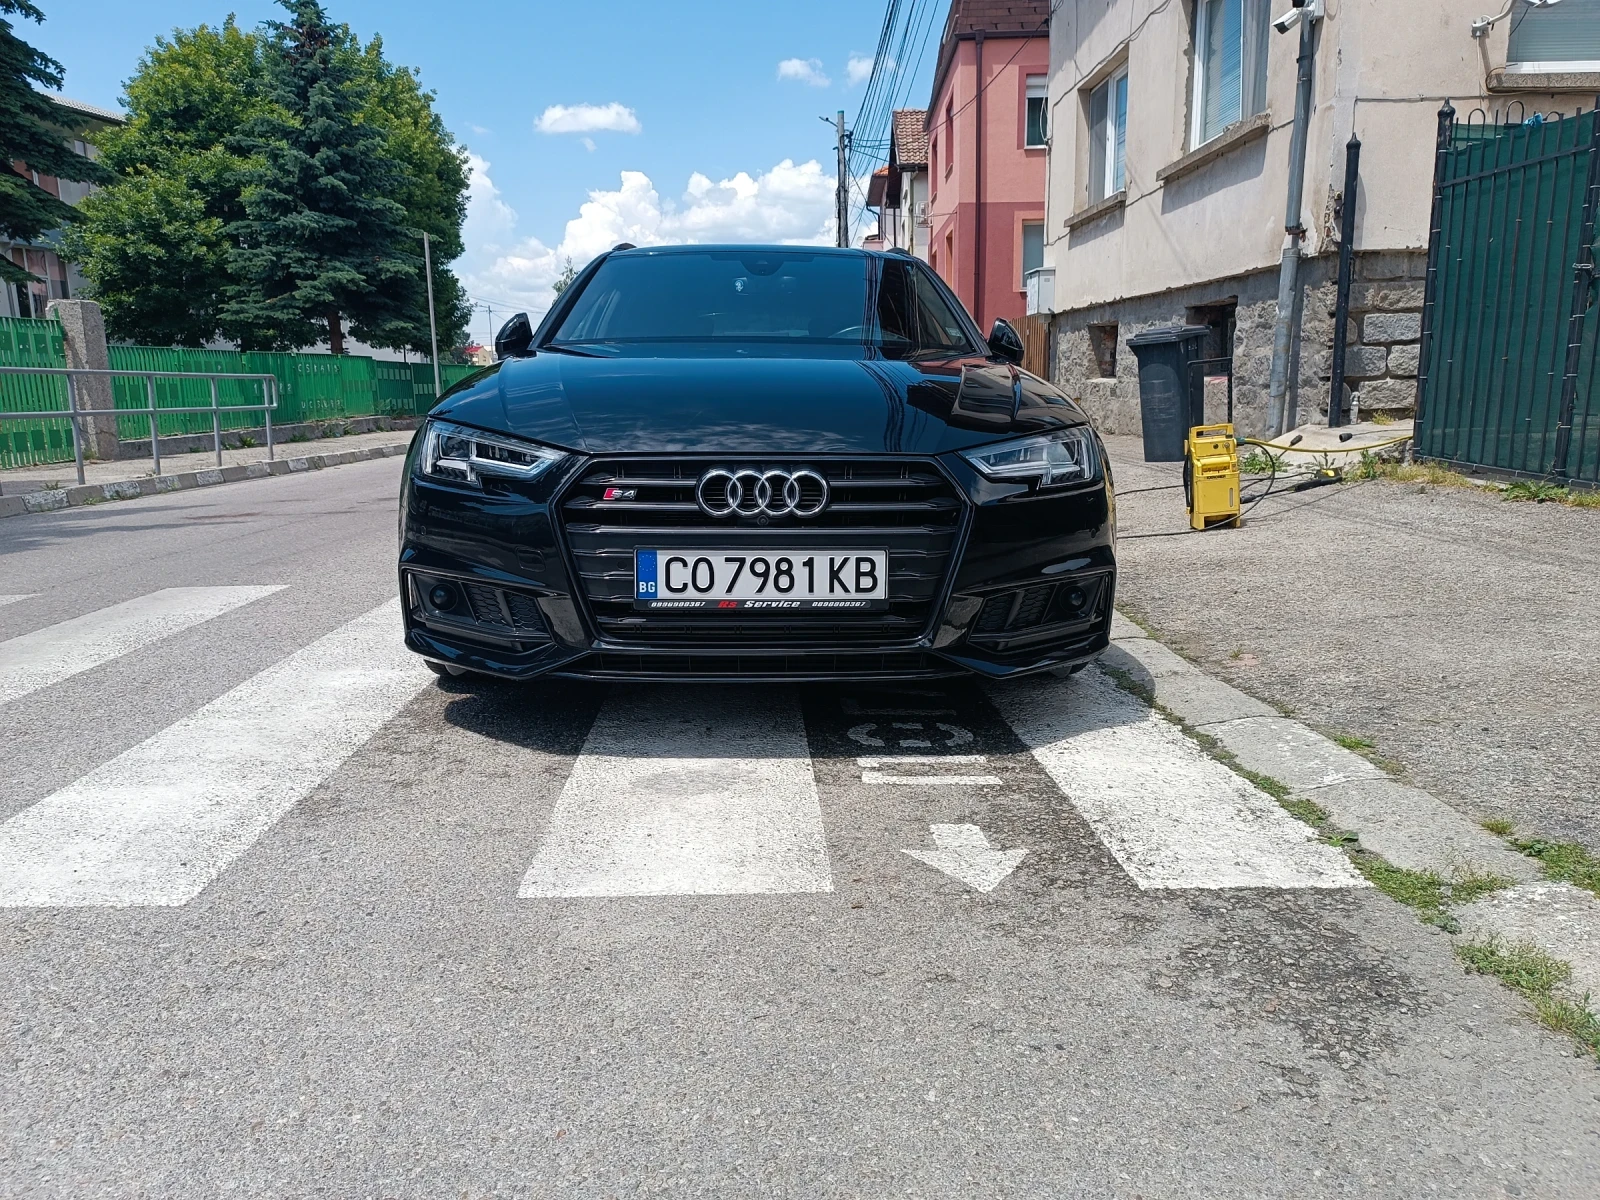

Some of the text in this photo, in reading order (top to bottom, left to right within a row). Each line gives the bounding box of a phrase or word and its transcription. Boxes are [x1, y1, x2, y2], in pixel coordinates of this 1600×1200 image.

[610, 489, 636, 499] S4
[639, 581, 656, 593] BG
[744, 600, 801, 608] Service
